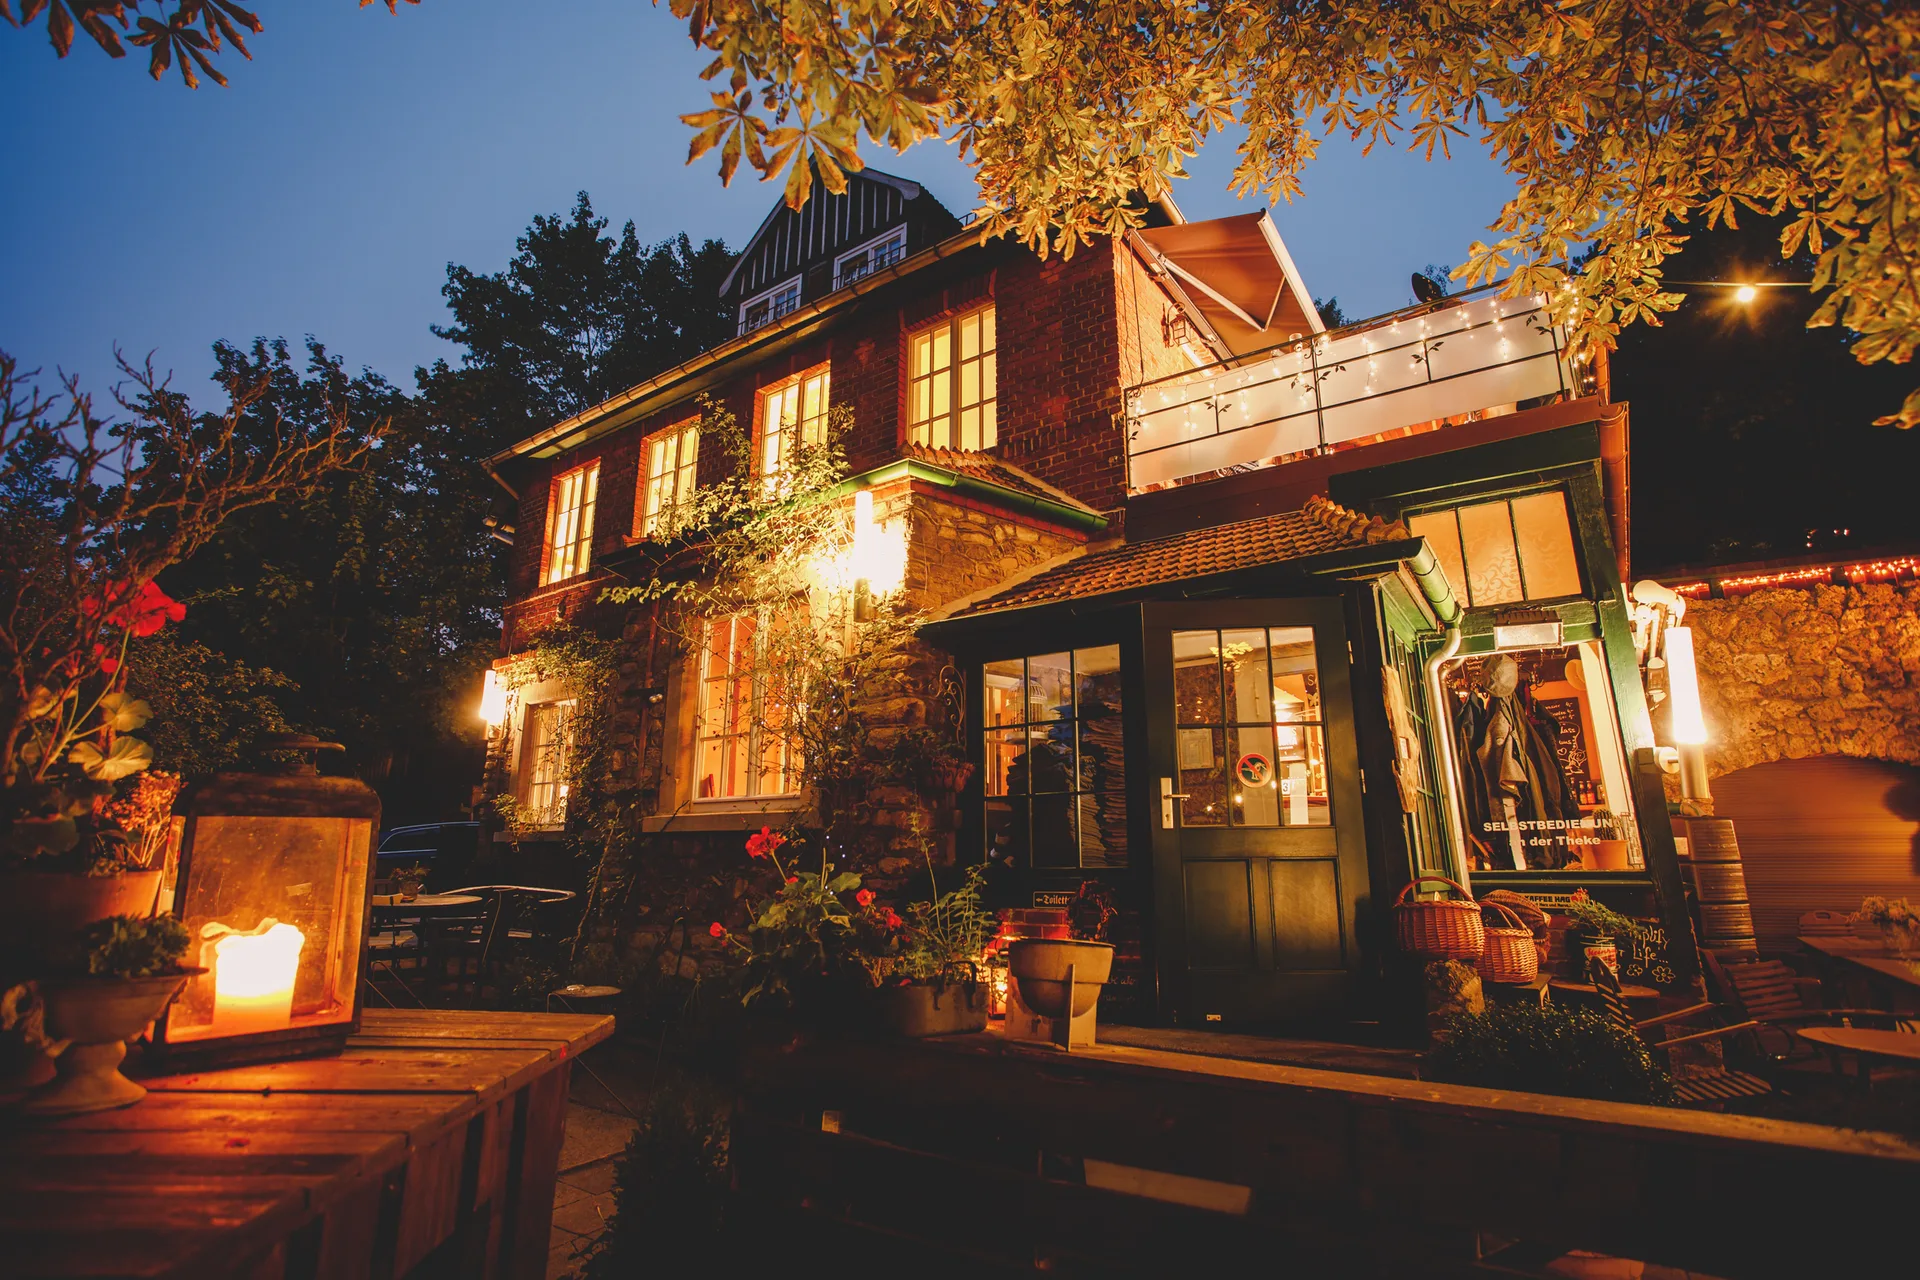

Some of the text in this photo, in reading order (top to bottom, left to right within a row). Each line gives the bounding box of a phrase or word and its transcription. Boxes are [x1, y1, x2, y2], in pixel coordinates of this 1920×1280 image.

[1483, 818, 1621, 832] SELBSTBEDIEUN
[1529, 836, 1553, 846] der
[1555, 835, 1601, 846] Theke
[1043, 894, 1070, 905] Toilett
[1554, 895, 1571, 903] HAG
[1641, 925, 1670, 951] plify
